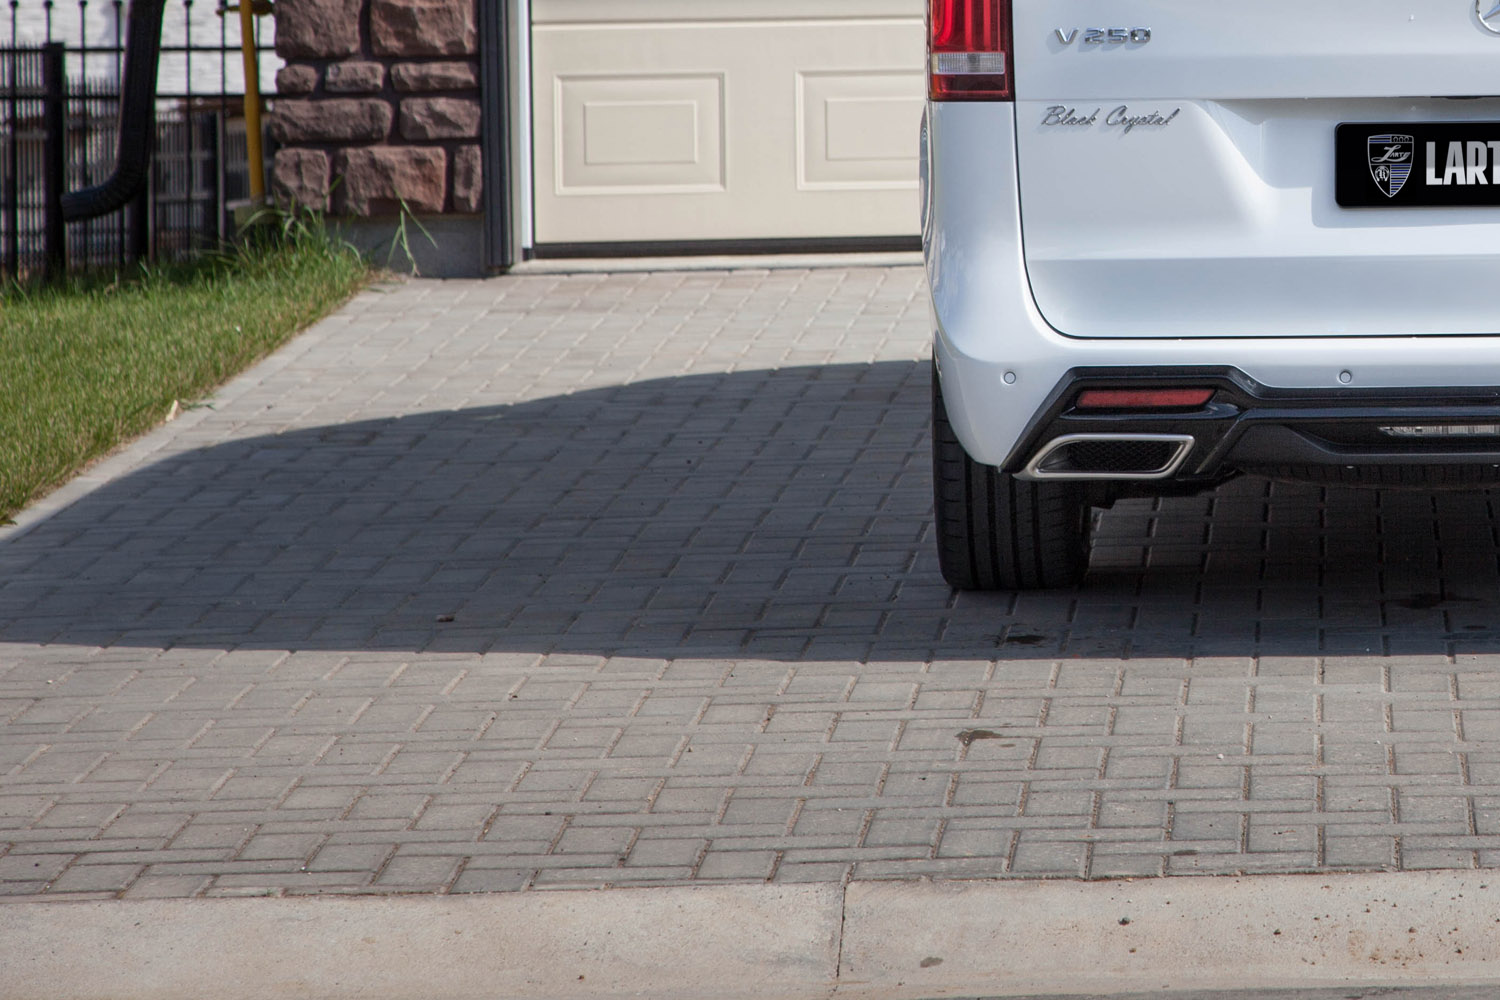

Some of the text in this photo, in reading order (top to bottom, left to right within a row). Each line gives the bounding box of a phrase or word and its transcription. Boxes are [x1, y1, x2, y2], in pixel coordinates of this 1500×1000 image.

[1054, 27, 1152, 45] V 250
[1041, 105, 1181, 134] Black Crystal
